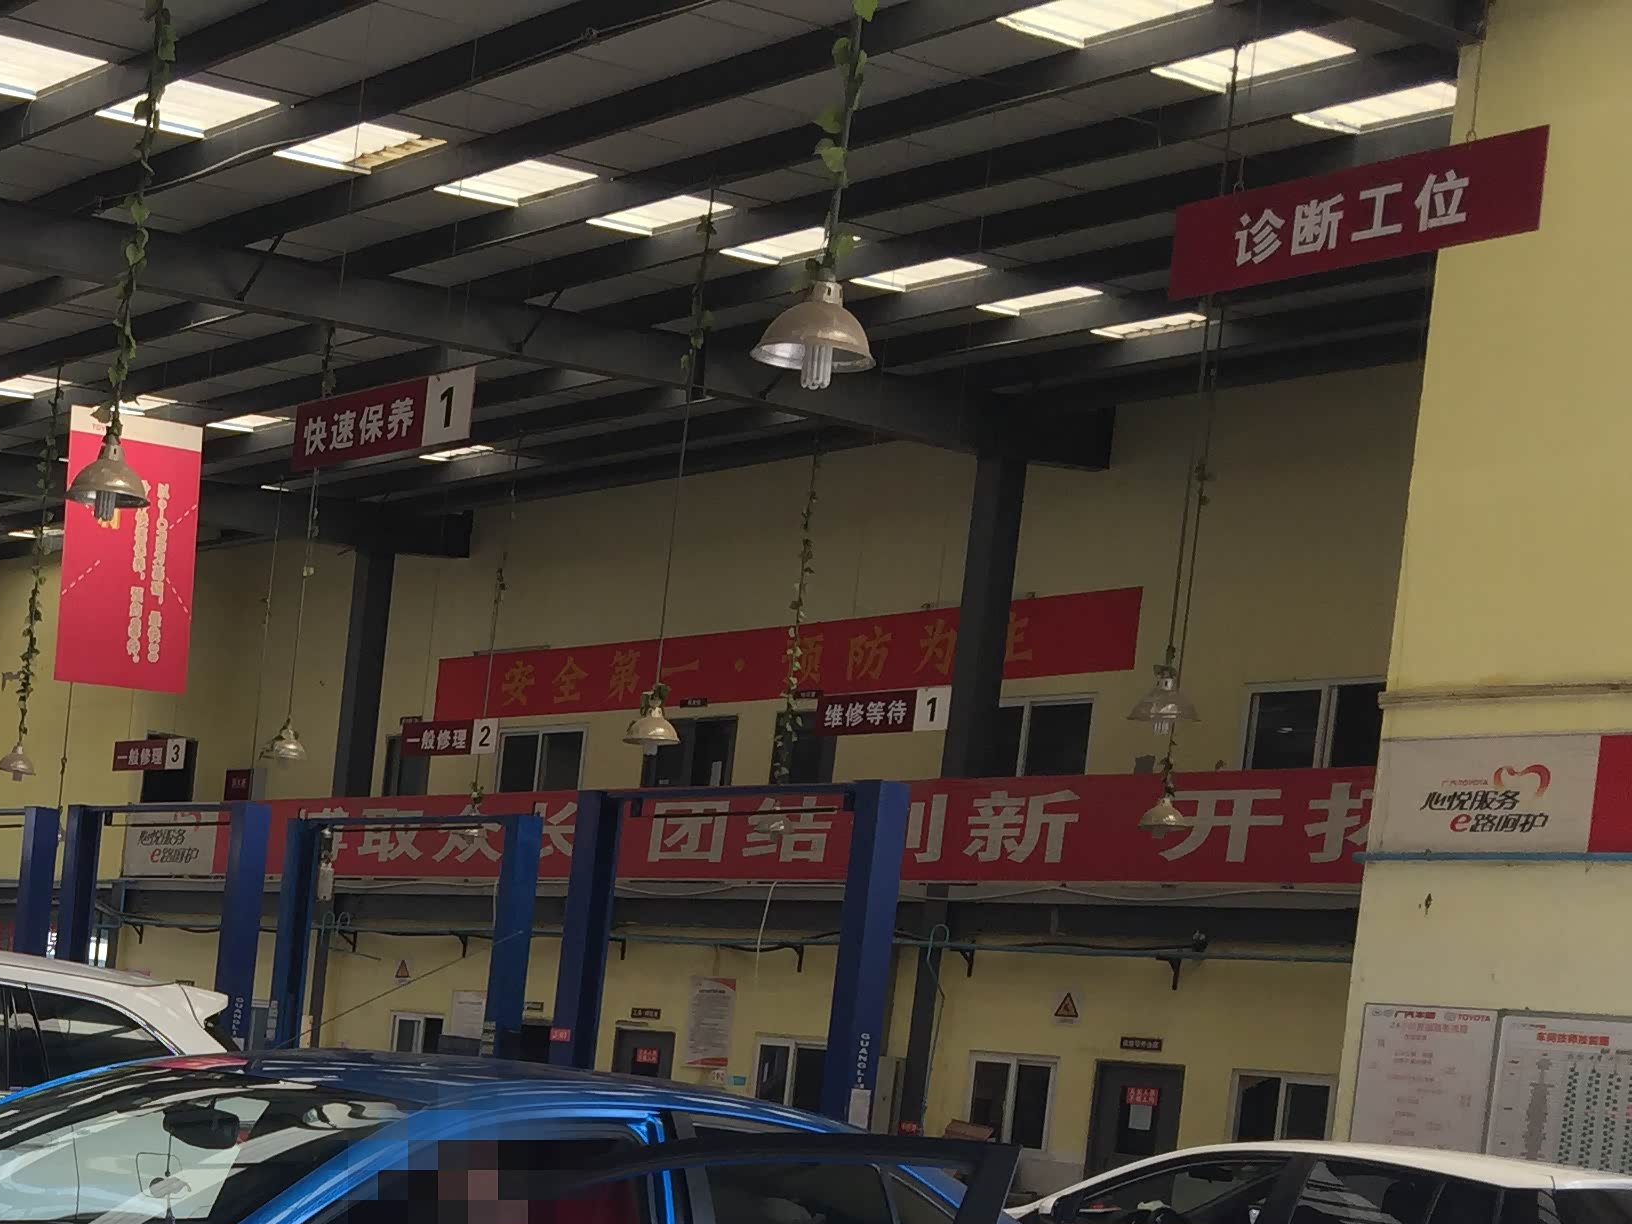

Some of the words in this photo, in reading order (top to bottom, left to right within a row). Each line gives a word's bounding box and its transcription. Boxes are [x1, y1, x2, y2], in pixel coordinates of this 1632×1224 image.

[1234, 168, 1470, 267] 诊断工位
[303, 396, 415, 457] 快速保养
[440, 386, 455, 429] 1
[823, 699, 909, 728] 维修等待
[926, 696, 938, 723] 1
[406, 729, 467, 751] 一般修理
[478, 725, 491, 748] 2
[117, 747, 164, 766] 一般修理
[171, 744, 181, 763] 3
[1420, 789, 1521, 811] 心悦服务
[1449, 812, 1549, 834] e路呵护
[1458, 1013, 1491, 1022] TOYOTA
